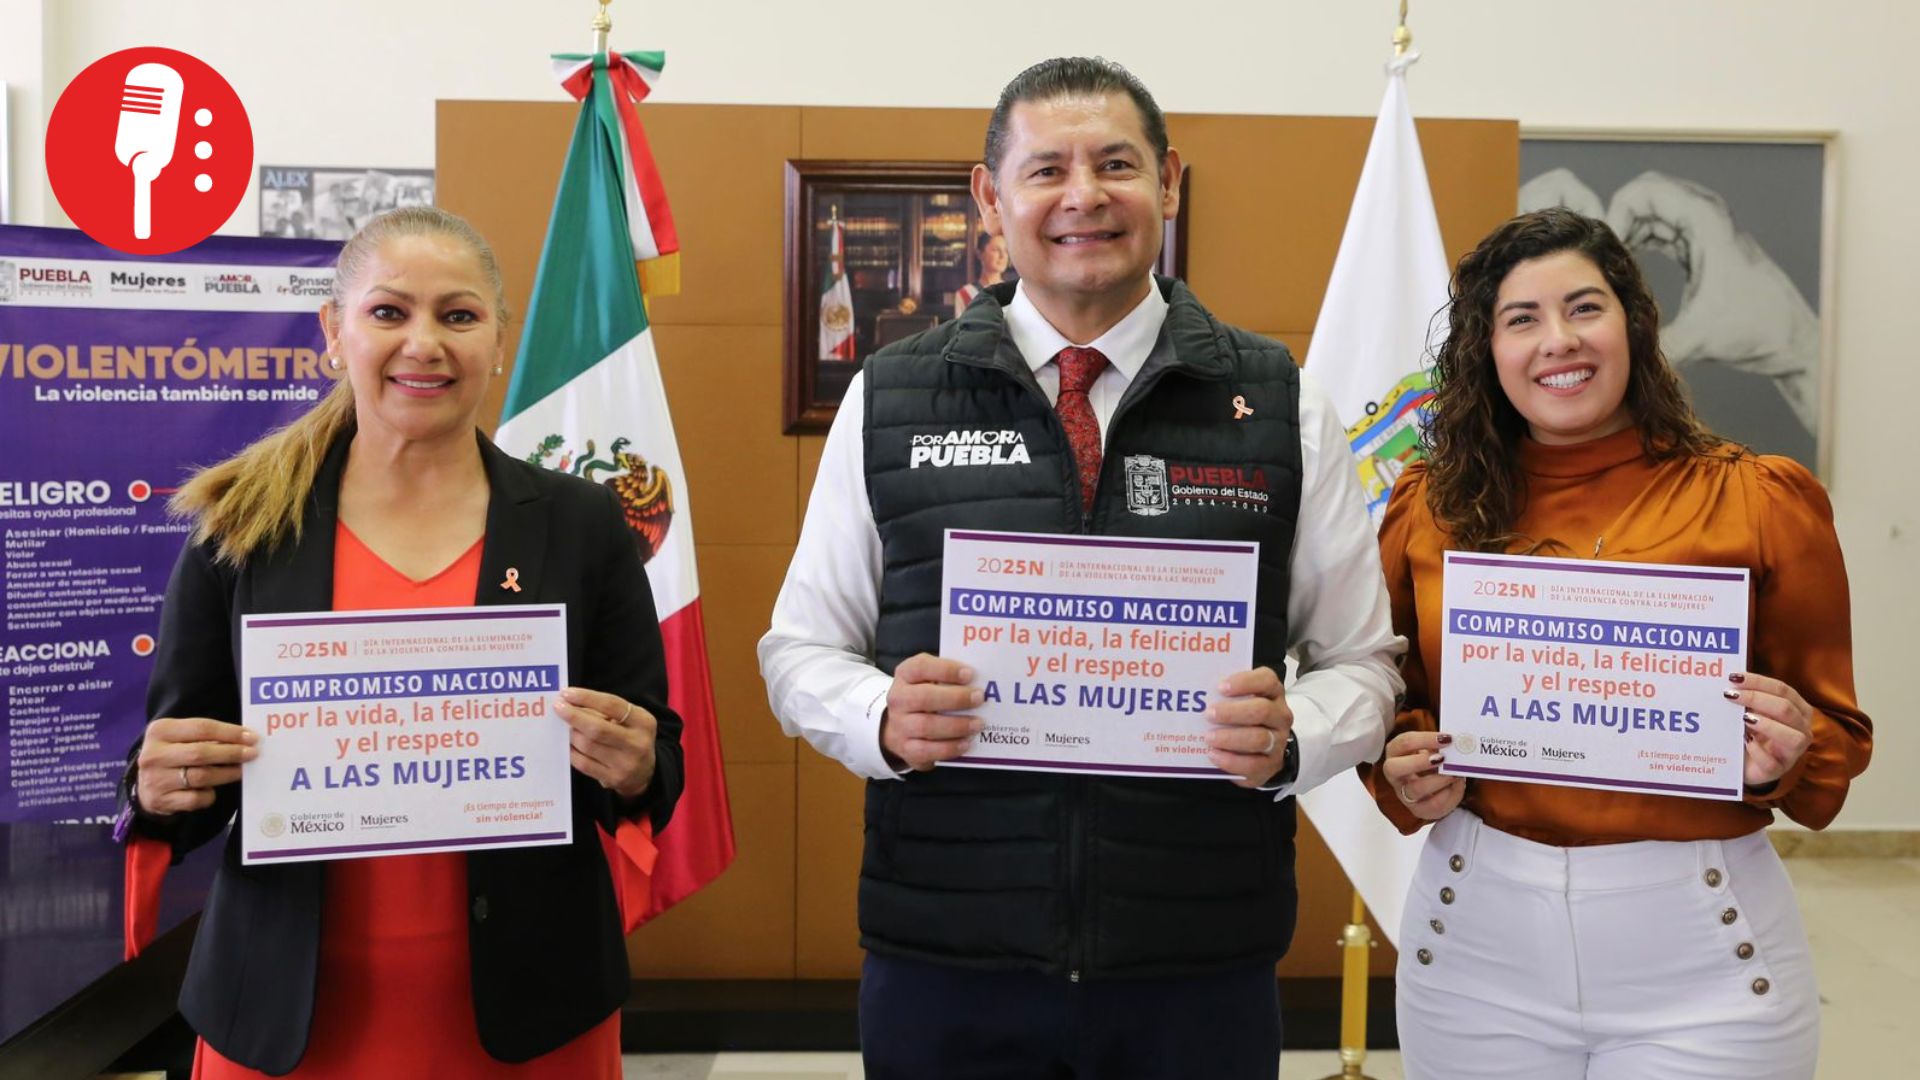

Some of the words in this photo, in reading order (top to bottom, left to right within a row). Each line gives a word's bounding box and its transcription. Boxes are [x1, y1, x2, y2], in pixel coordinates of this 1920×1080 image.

[265, 169, 307, 187] ALEX
[20, 268, 91, 283] PUEBLA
[111, 272, 186, 289] Mujeres
[290, 274, 334, 287] Pensar
[205, 282, 260, 294] PUEBLA
[35, 385, 59, 401] La
[62, 384, 158, 402] violencia
[160, 384, 244, 402] también
[246, 388, 268, 401] se
[271, 384, 318, 401] mide
[910, 444, 1032, 468] PUEBLA
[1170, 465, 1267, 488] PUEBLA
[0, 480, 110, 505] ELIGRO
[1172, 484, 1218, 496] Gobierno
[1220, 487, 1234, 496] del
[1238, 488, 1268, 502] Estado
[34, 508, 70, 520] ayuda
[74, 506, 136, 519] profesional
[6, 528, 61, 538] Asesinar
[64, 526, 130, 538] (Homicidio
[141, 522, 191, 534] Feminici
[6, 540, 46, 549] Mutilar
[6, 560, 37, 569] Abuso
[40, 559, 72, 568] sexual
[976, 558, 1044, 576] 2025N
[6, 572, 38, 580] Forzar
[68, 568, 108, 576] relación
[110, 566, 141, 574] sexual
[6, 580, 55, 589] Amenazar
[72, 578, 107, 586] muerte
[1474, 580, 1536, 599] 2025N
[7, 591, 46, 600] Difundir
[50, 588, 97, 598] contenido
[1550, 584, 1564, 592] DÍA
[1566, 586, 1630, 598] INTERNACIONAL
[1659, 590, 1714, 602] ELIMINACIÓN
[8, 600, 84, 610] consentimiento
[86, 600, 102, 608] por
[104, 596, 138, 604] medios
[958, 592, 1114, 620] COMPROMISO
[1123, 602, 1239, 624] NACIONAL
[1575, 596, 1617, 604] VIOLENCIA
[1620, 598, 1650, 606] CONTRA
[1653, 600, 1668, 608] LAS
[1671, 602, 1706, 610] MUJERES
[8, 612, 56, 620] Amenazar
[79, 608, 115, 617] objetos
[8, 620, 62, 630] Sextorción
[1457, 614, 1604, 640] COMPROMISO
[1614, 625, 1731, 650] NACIONAL
[963, 624, 1003, 646] por
[1010, 624, 1030, 644] la
[1038, 625, 1094, 650] vida,
[1102, 628, 1123, 648] la
[1130, 629, 1231, 653] felicidad
[0, 640, 110, 662] ACCIONA
[278, 640, 347, 658] 2025N
[1026, 656, 1040, 676] y
[1047, 653, 1067, 672] el
[1075, 656, 1164, 681] respeto
[1462, 642, 1499, 663] por
[1506, 642, 1525, 662] la
[1532, 645, 1586, 670] vida,
[1594, 649, 1613, 669] la
[1620, 650, 1724, 678] felicidad
[13, 664, 46, 677] dejes
[48, 660, 95, 672] destruir
[9, 684, 64, 696] Encerrar
[78, 680, 112, 690] aislar
[259, 674, 422, 699] COMPROMISO
[432, 670, 552, 692] NACIONAL
[1522, 673, 1536, 694] y
[1542, 672, 1560, 691] el
[1568, 676, 1656, 700] respeto
[9, 697, 46, 706] Patear
[983, 680, 1002, 703] A
[1014, 682, 1067, 706] LAS
[1078, 686, 1208, 714] MUJERES
[10, 706, 60, 716] Cachetear
[266, 711, 309, 736] por
[316, 706, 338, 727] la
[346, 704, 405, 727] vida,
[413, 701, 434, 722] la
[441, 697, 545, 720] felicidad
[1481, 696, 1500, 718] A
[1510, 698, 1561, 722] LAS
[1572, 704, 1700, 734] MUJERES
[10, 717, 50, 726] Empujar
[61, 713, 100, 724] jalonear
[10, 726, 52, 736] Pellizcar
[1044, 732, 1090, 744] Mujeres
[1156, 733, 1186, 743] tiempo
[1188, 734, 1198, 742] de
[10, 738, 48, 747] Golpear
[336, 738, 350, 760] y
[358, 732, 378, 752] el
[386, 729, 480, 756] respeto
[980, 732, 1030, 745] México
[1480, 736, 1517, 746] Gobierno
[10, 748, 50, 757] Caricias
[53, 743, 100, 754] agresivas
[1480, 743, 1527, 758] México
[1542, 747, 1586, 759] Mujeres
[1651, 752, 1680, 760] tiempo
[1694, 754, 1727, 764] mujeres
[290, 768, 312, 790] A
[324, 764, 380, 789] LAS
[393, 756, 526, 788] MUJERES
[1666, 764, 1715, 774] violencia!
[477, 802, 507, 811] tiempo
[520, 800, 554, 810] mujeres
[290, 812, 332, 820] Gobierno
[360, 814, 409, 826] Mujeres
[476, 814, 491, 824] sin
[494, 812, 543, 822] violencia!
[290, 820, 344, 834] México
